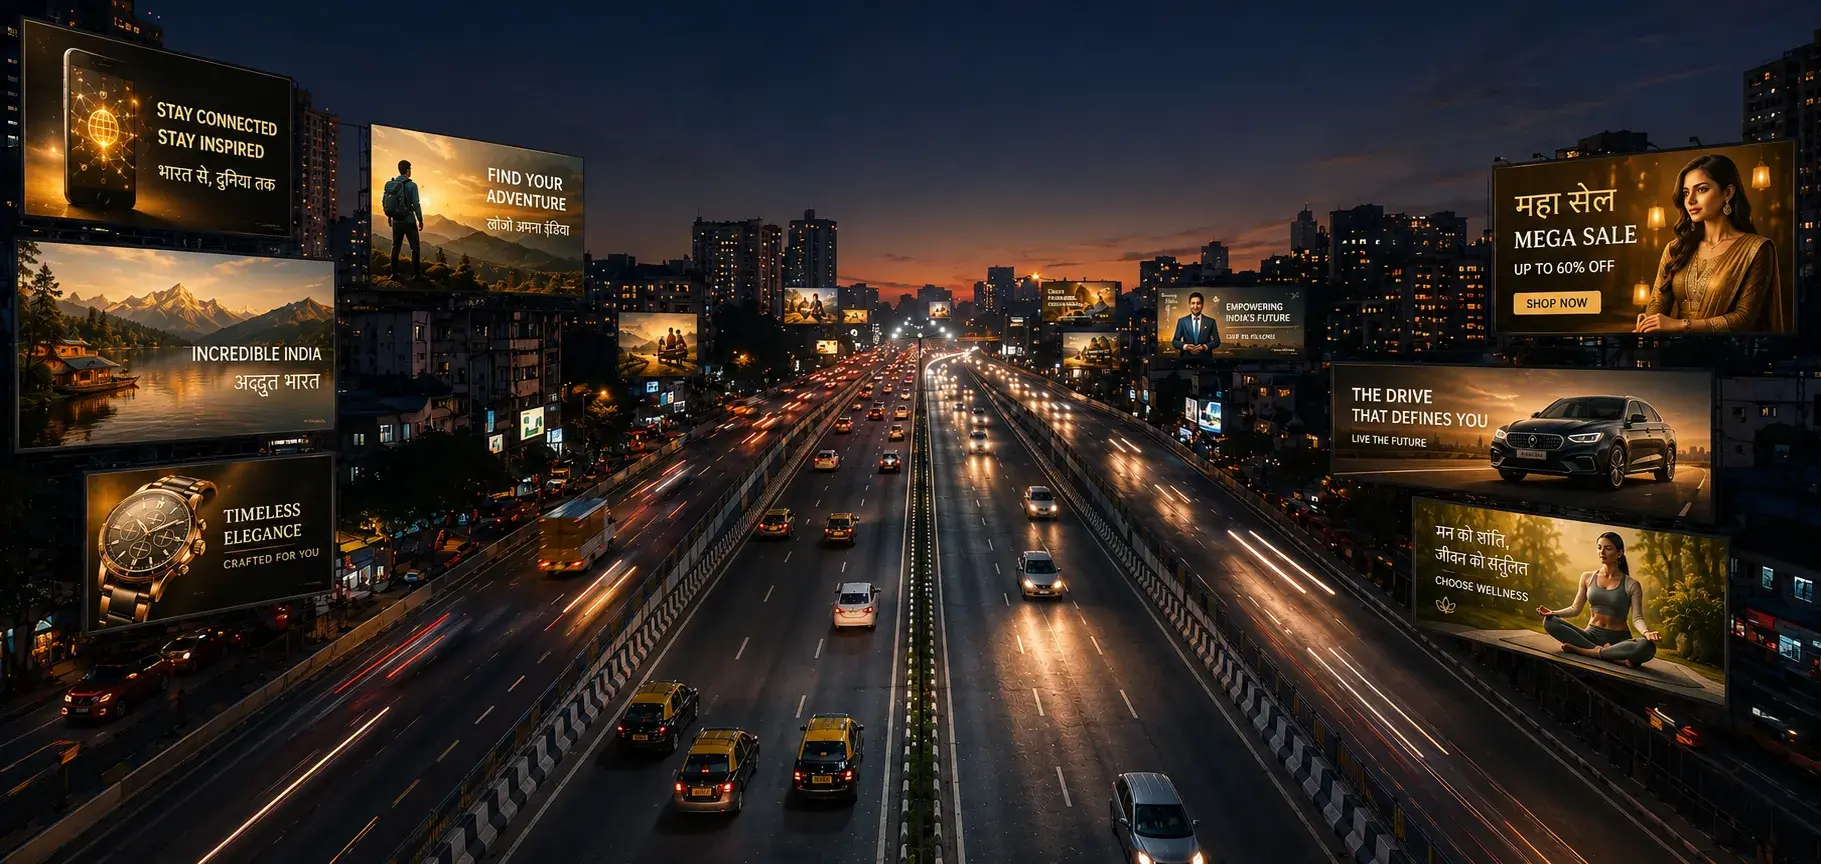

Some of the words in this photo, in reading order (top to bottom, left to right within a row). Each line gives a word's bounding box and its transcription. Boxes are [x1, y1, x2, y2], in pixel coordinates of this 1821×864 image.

[157, 101, 193, 121] STAY
[196, 109, 278, 137] CONNECTED
[157, 128, 196, 149] STAY
[200, 135, 264, 159] INSPIRED
[158, 164, 193, 182] भारत
[196, 165, 212, 187] से,
[216, 169, 252, 191] दुनिया
[255, 177, 276, 191] तक
[488, 167, 521, 185] FIND
[525, 172, 563, 191] YOUR
[486, 189, 567, 211] ADVENTURE
[1514, 193, 1562, 219] महा
[1567, 182, 1618, 214] सेल
[1514, 228, 1577, 249] MEGA
[1583, 224, 1638, 246] SALE
[1514, 263, 1532, 276] UP
[1535, 262, 1553, 275] TO
[1557, 260, 1585, 274] 60%
[1588, 259, 1615, 273] OFF
[1226, 302, 1283, 311] EMPOWERING
[1526, 298, 1557, 309] SHOP
[1560, 297, 1588, 308] NOW
[1225, 314, 1255, 322] INDIA'S
[1257, 314, 1291, 322] FUTURE
[192, 346, 280, 361] INCREDIBLE
[284, 346, 322, 361] INDIA
[284, 373, 320, 390] भारत
[1351, 387, 1381, 402] THE
[1386, 388, 1433, 404] DRIVE
[1351, 408, 1388, 423] THAT
[1391, 410, 1452, 426] DEFINES
[1456, 412, 1488, 428] YOU
[1351, 433, 1370, 444] LIVE
[1372, 435, 1389, 445] THE
[1391, 436, 1427, 448] FUTURE
[223, 502, 301, 524] TIMELESS
[224, 523, 302, 546] ELEGANCE
[1435, 525, 1454, 540] मन
[1457, 524, 1473, 542] को
[223, 554, 272, 569] CRAFTED
[276, 551, 296, 562] FOR
[299, 547, 319, 559] YOU
[1435, 545, 1467, 566] जीवन
[1469, 550, 1485, 569] को
[1435, 575, 1474, 591] CHOOSE
[1476, 583, 1529, 602] WELLNESS
